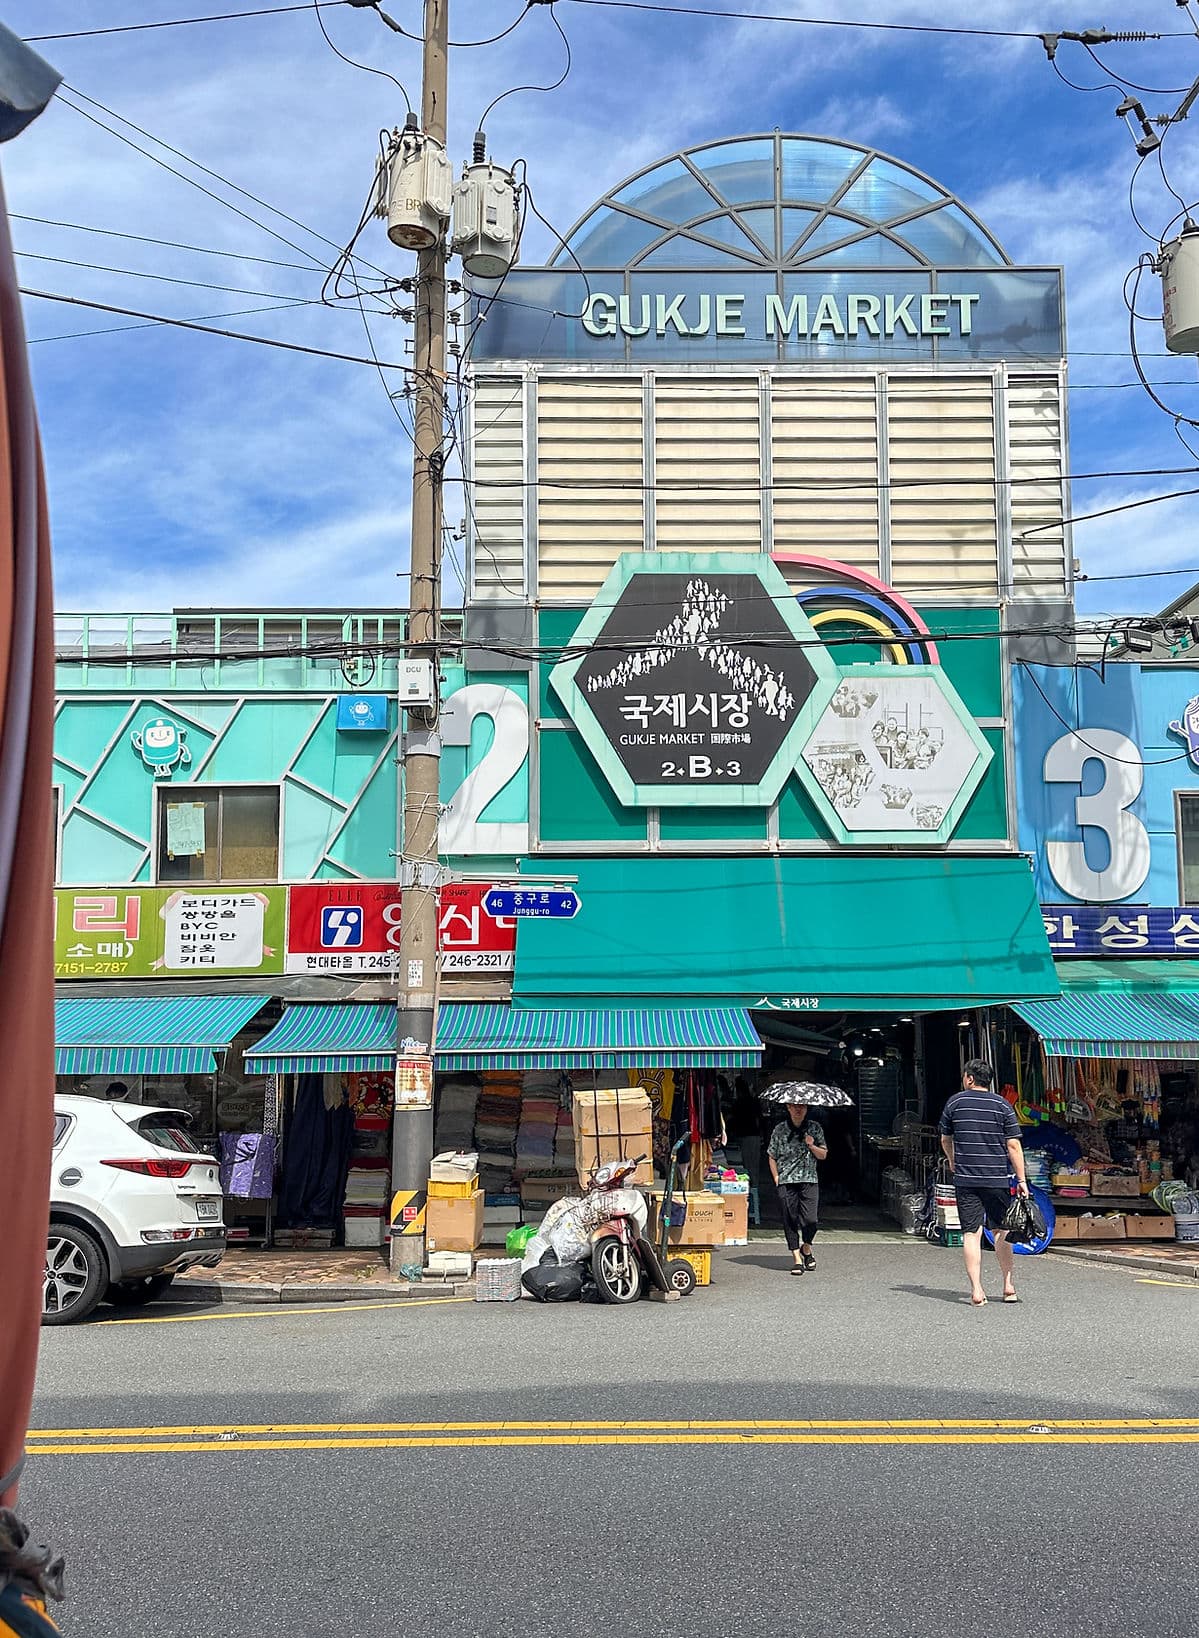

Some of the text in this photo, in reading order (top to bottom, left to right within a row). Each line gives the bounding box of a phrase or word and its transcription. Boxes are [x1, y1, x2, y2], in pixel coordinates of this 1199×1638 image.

[581, 292, 980, 337] GUKJE MARKET
[619, 693, 752, 729] 국제시장
[619, 733, 656, 746] GUKJE
[659, 733, 705, 745] MARKET
[438, 683, 529, 854] 2
[661, 755, 741, 778] 2 B 3
[1043, 728, 1151, 902] 3
[181, 899, 257, 908] 보디가드
[490, 899, 503, 908] 46
[513, 892, 550, 905] 중구로
[560, 900, 572, 909] 42
[512, 907, 550, 916] Junggu-ro
[180, 922, 219, 930] BYC
[180, 932, 237, 942] 비비안
[180, 954, 215, 964] 키티
[306, 956, 353, 969] 현대타올
[781, 997, 819, 1009] 국제시장
